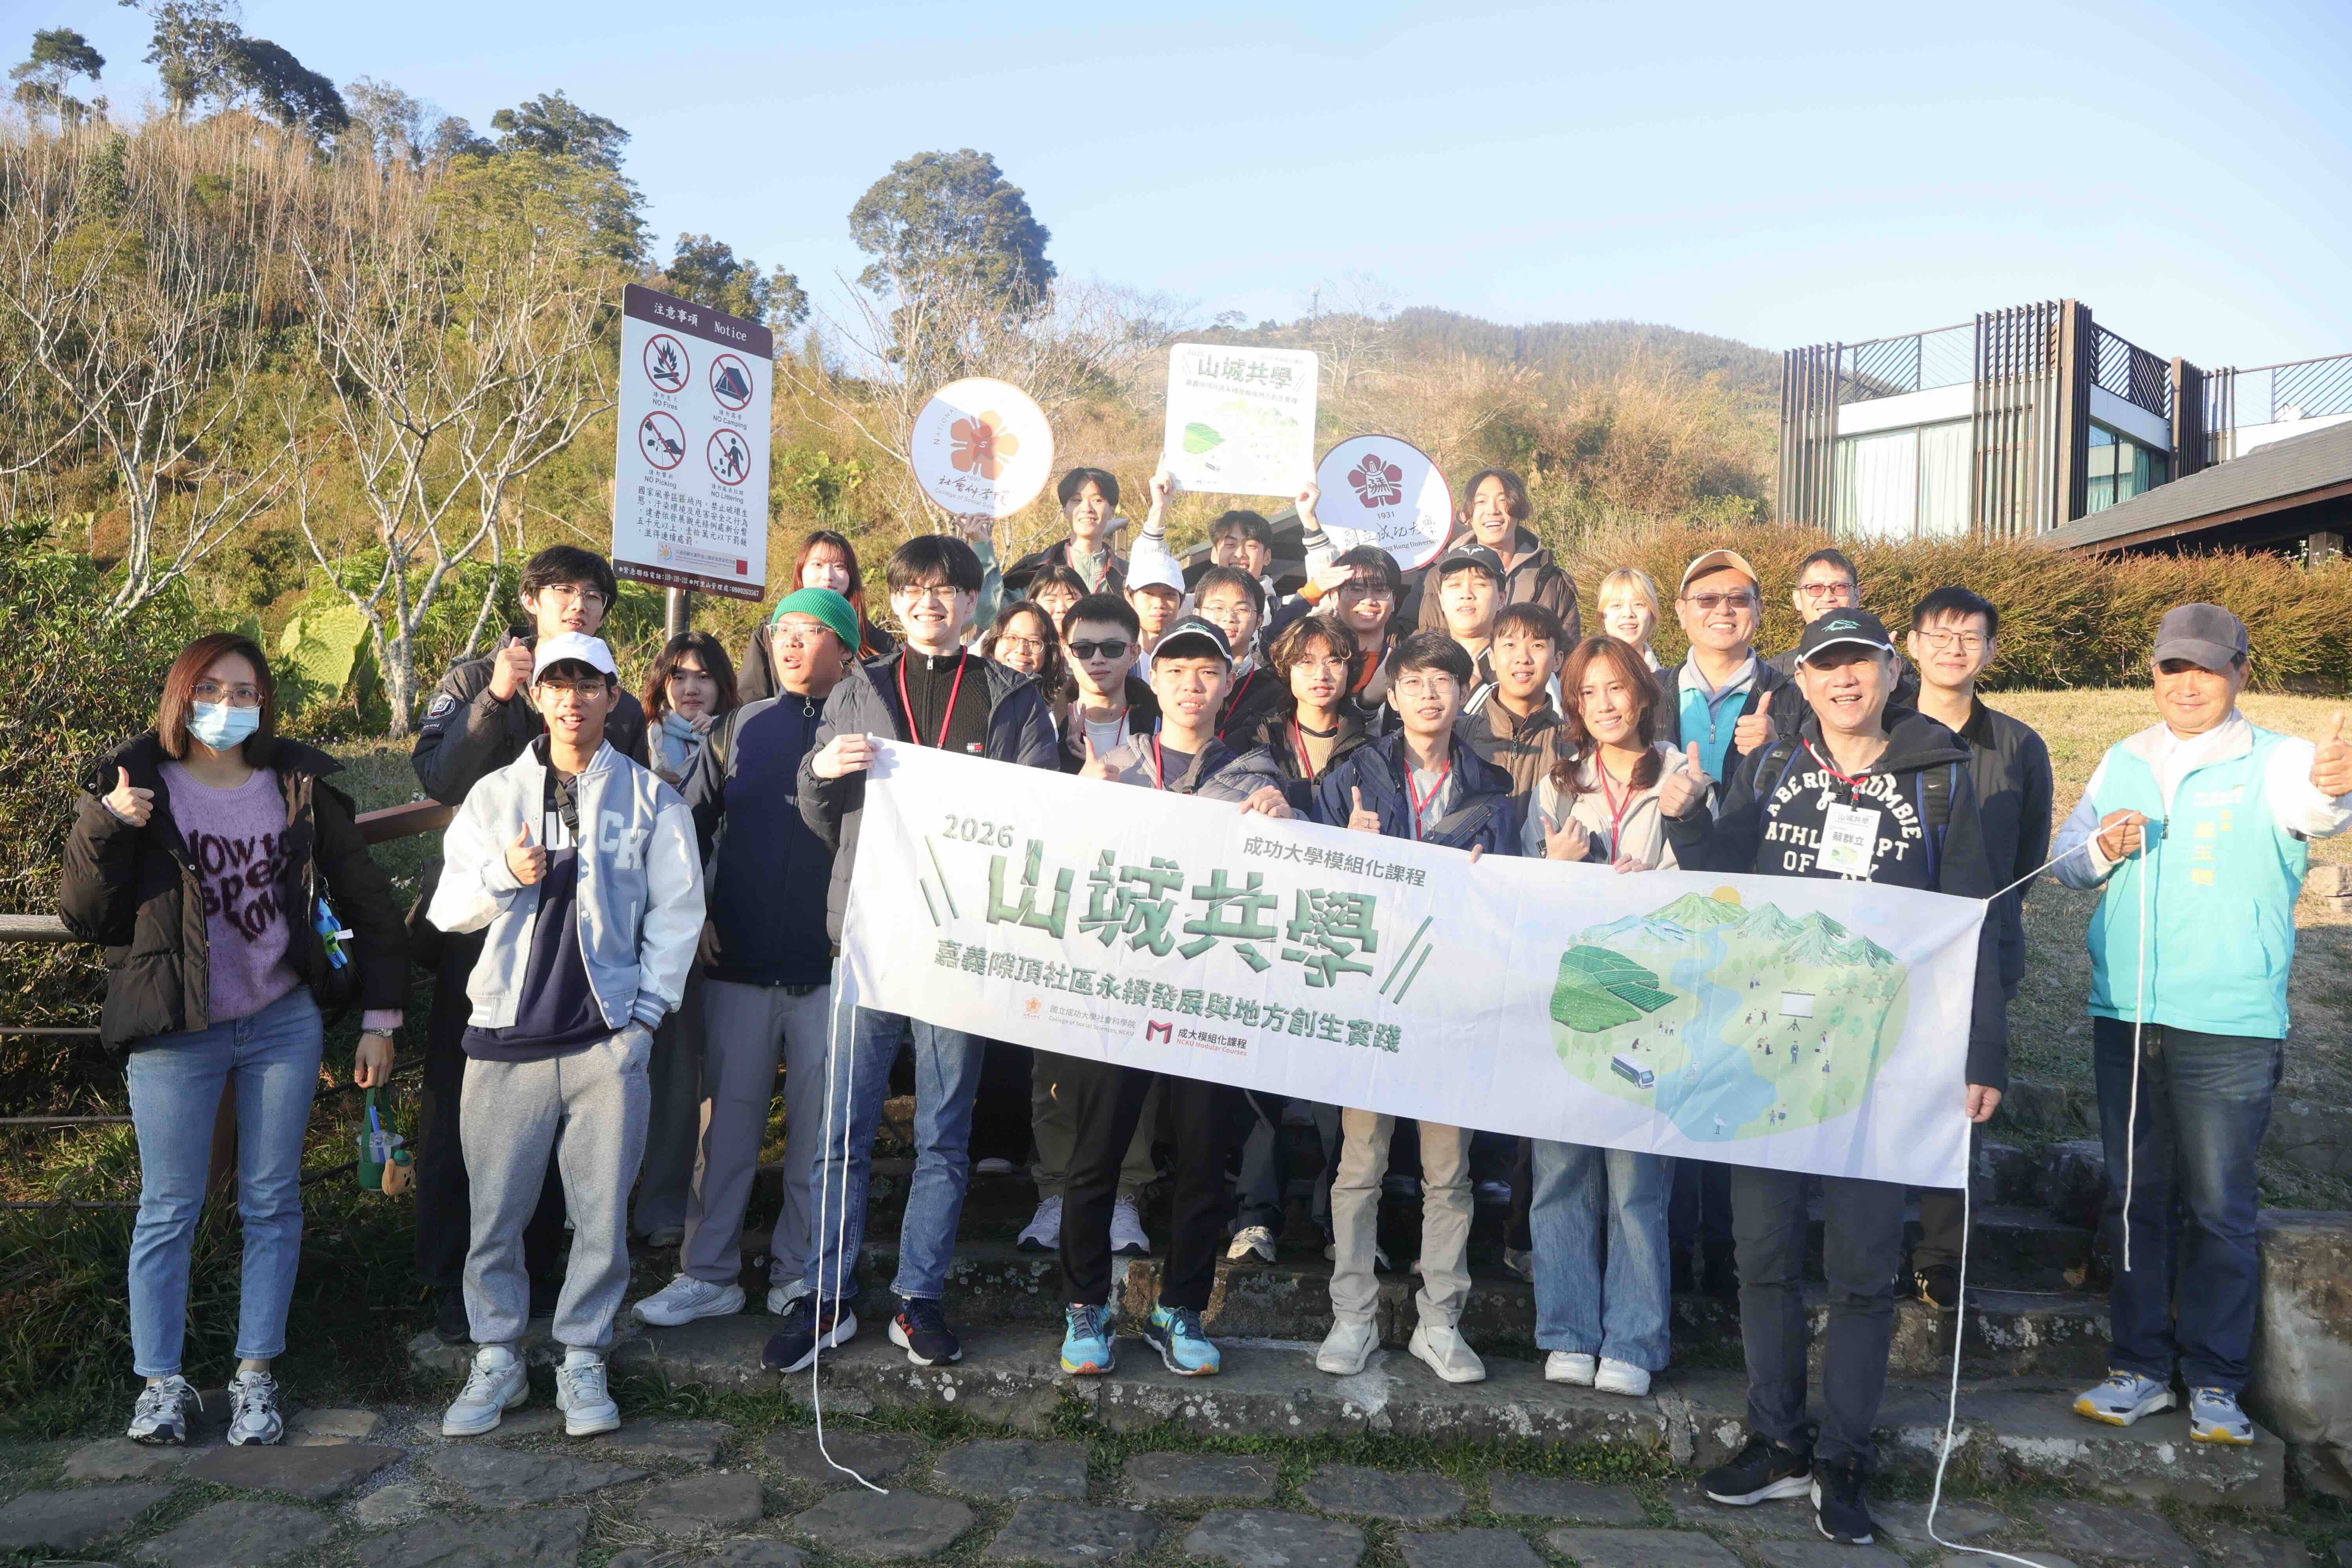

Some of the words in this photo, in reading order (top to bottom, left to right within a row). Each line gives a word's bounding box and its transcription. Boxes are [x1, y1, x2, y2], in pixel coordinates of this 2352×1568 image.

[654, 302, 698, 327] 注意事項
[715, 321, 747, 341] Notice
[1198, 354, 1292, 389] 山城共學
[664, 401, 678, 410] Fires
[723, 417, 747, 430] Camping
[655, 478, 677, 490] Picking
[721, 492, 744, 505] Littering
[1377, 511, 1395, 520] 1931
[943, 814, 1015, 848] 2026
[1243, 836, 1426, 888] 成功大學模組化課程
[1783, 850, 1815, 873] OF
[986, 838, 1379, 988] 山城共學
[934, 939, 1402, 1053] 嘉義隙頂社區永續發展與地方創生實踐
[1048, 1015, 1069, 1024] College
[1049, 1005, 1136, 1029] 國立成功大學社會科學院
[1176, 1038, 1195, 1047] NCKU
[1195, 1042, 1221, 1051] Modular
[1222, 1046, 1248, 1056] Courses
[1178, 1028, 1247, 1049] 成大模組化課程
